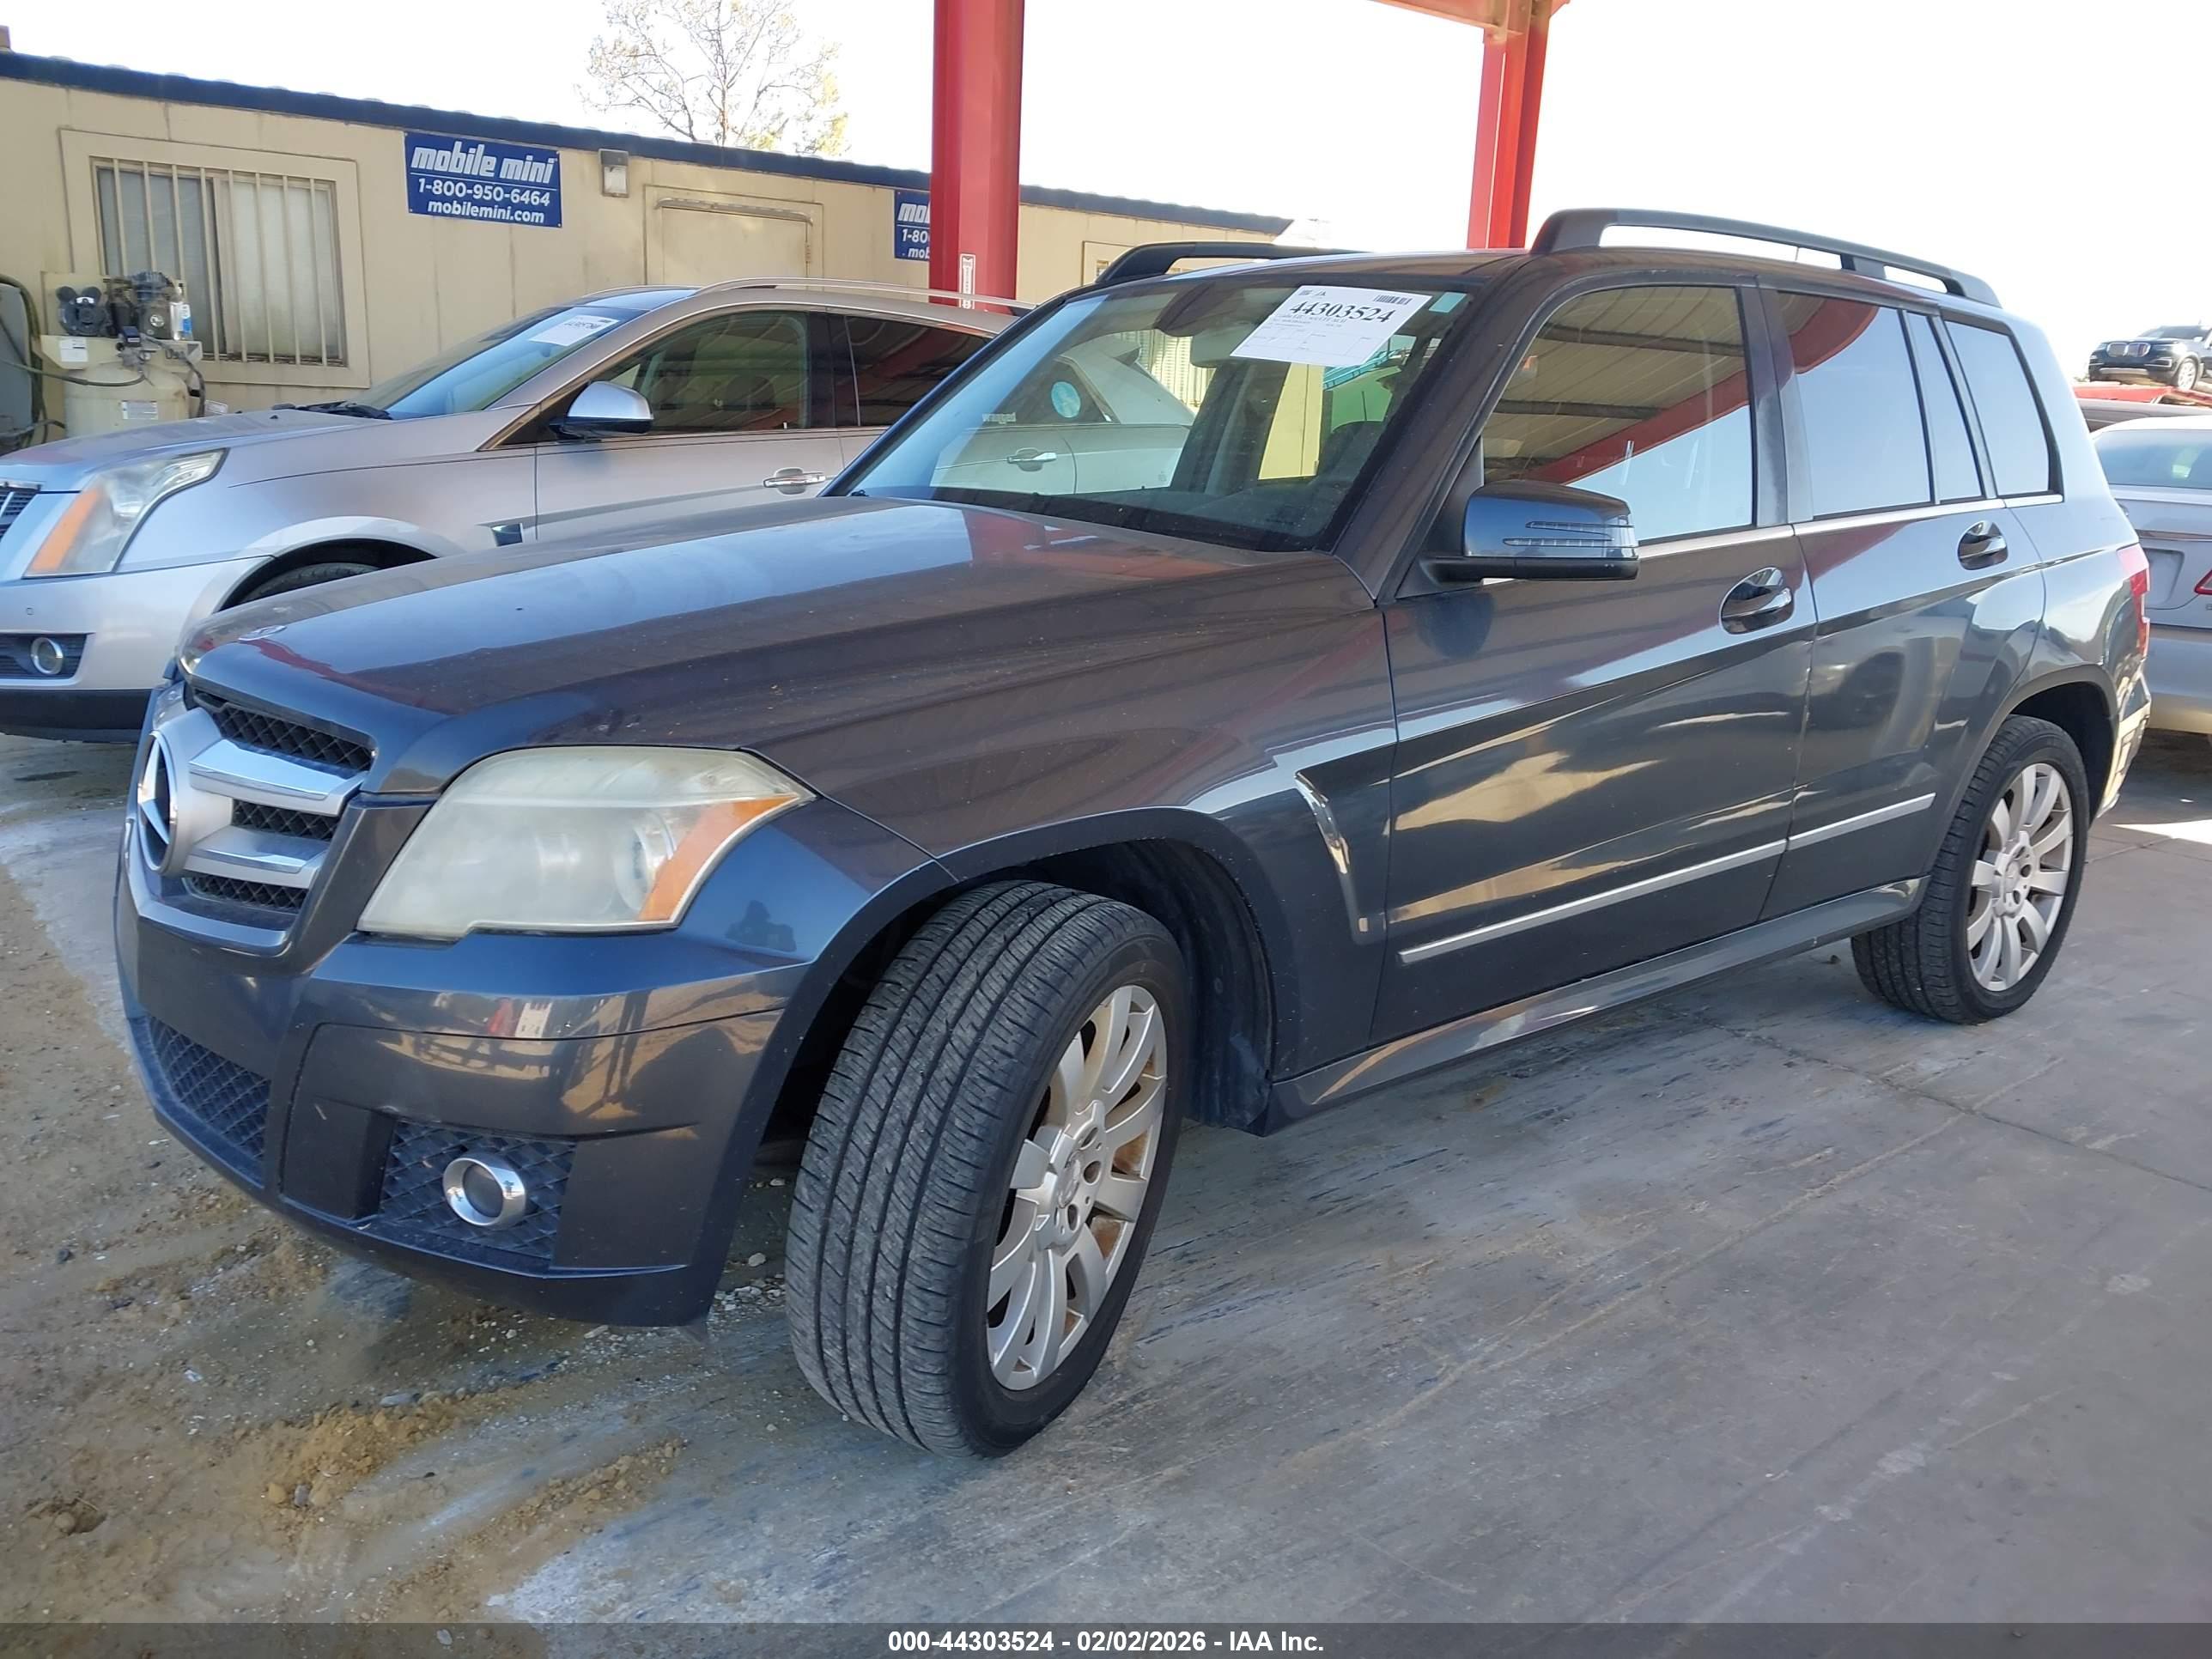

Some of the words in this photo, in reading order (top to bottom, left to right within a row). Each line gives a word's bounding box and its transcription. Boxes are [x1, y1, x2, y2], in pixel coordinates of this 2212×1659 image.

[410, 141, 497, 178] mobile
[499, 155, 556, 184] mini
[417, 178, 550, 207] 1-800-950-6464
[428, 200, 545, 223] mobilemini.com
[902, 228, 931, 244] 1-80
[1290, 301, 1396, 323] 44303524
